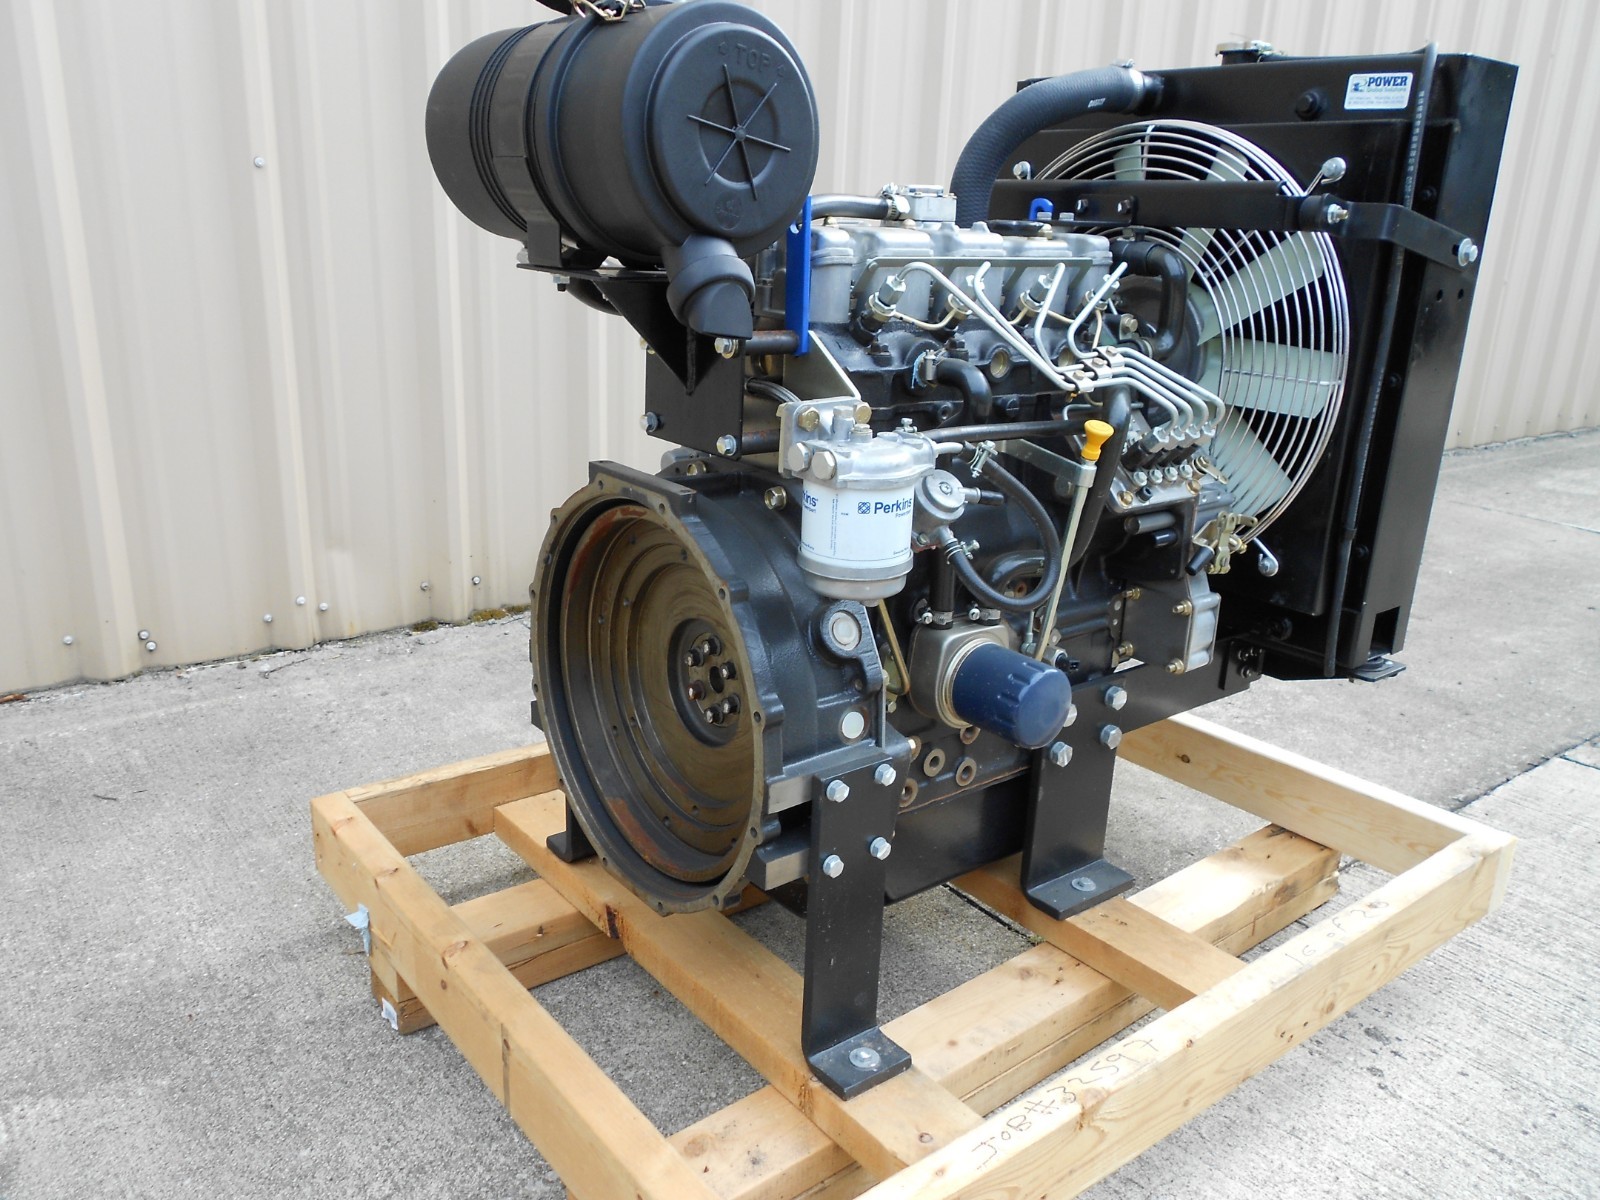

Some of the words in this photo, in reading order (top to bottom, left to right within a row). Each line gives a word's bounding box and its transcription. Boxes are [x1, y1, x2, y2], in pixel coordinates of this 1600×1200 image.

[735, 42, 771, 74] TOP
[1367, 76, 1408, 87] POWER
[874, 498, 912, 514] Perkins
